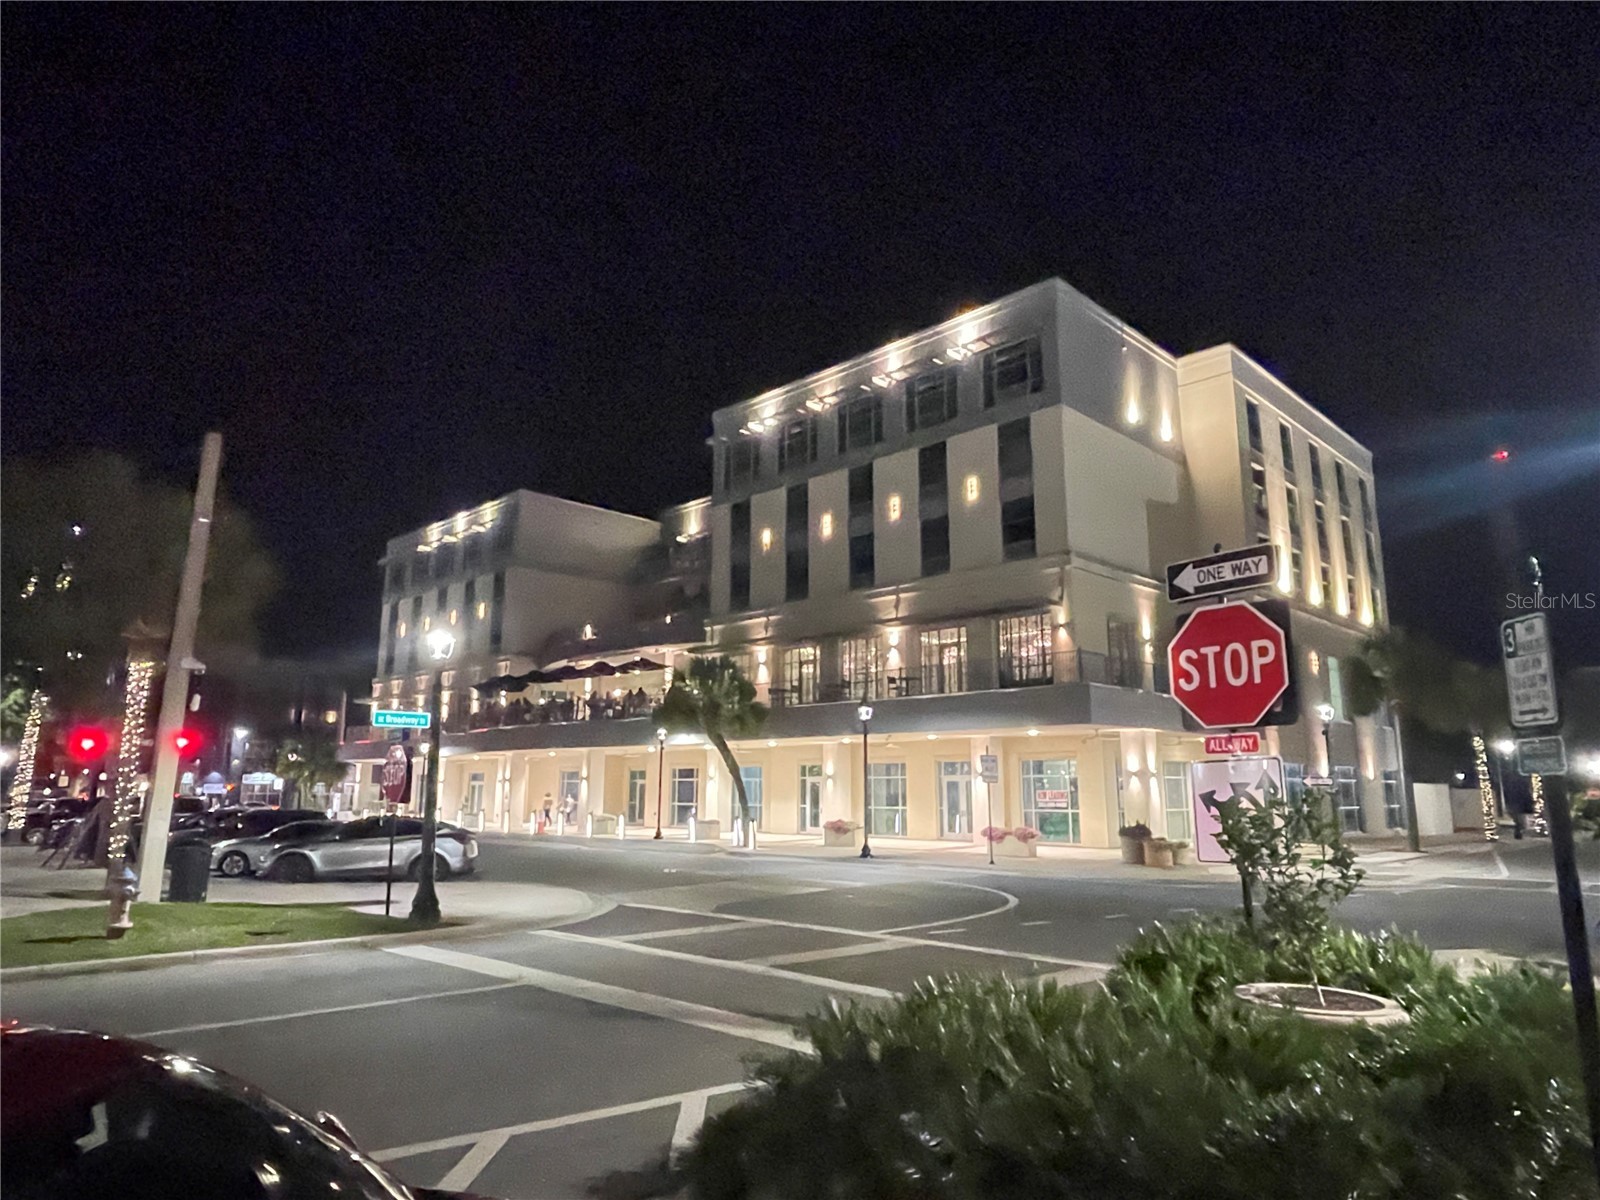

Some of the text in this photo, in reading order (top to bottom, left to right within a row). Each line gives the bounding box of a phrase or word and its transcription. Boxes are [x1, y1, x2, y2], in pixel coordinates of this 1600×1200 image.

[1197, 558, 1262, 583] ONE WAY
[1505, 628, 1515, 652] 3
[1179, 639, 1276, 691] STOP
[1209, 739, 1229, 752] ALL
[383, 763, 405, 787] STOP
